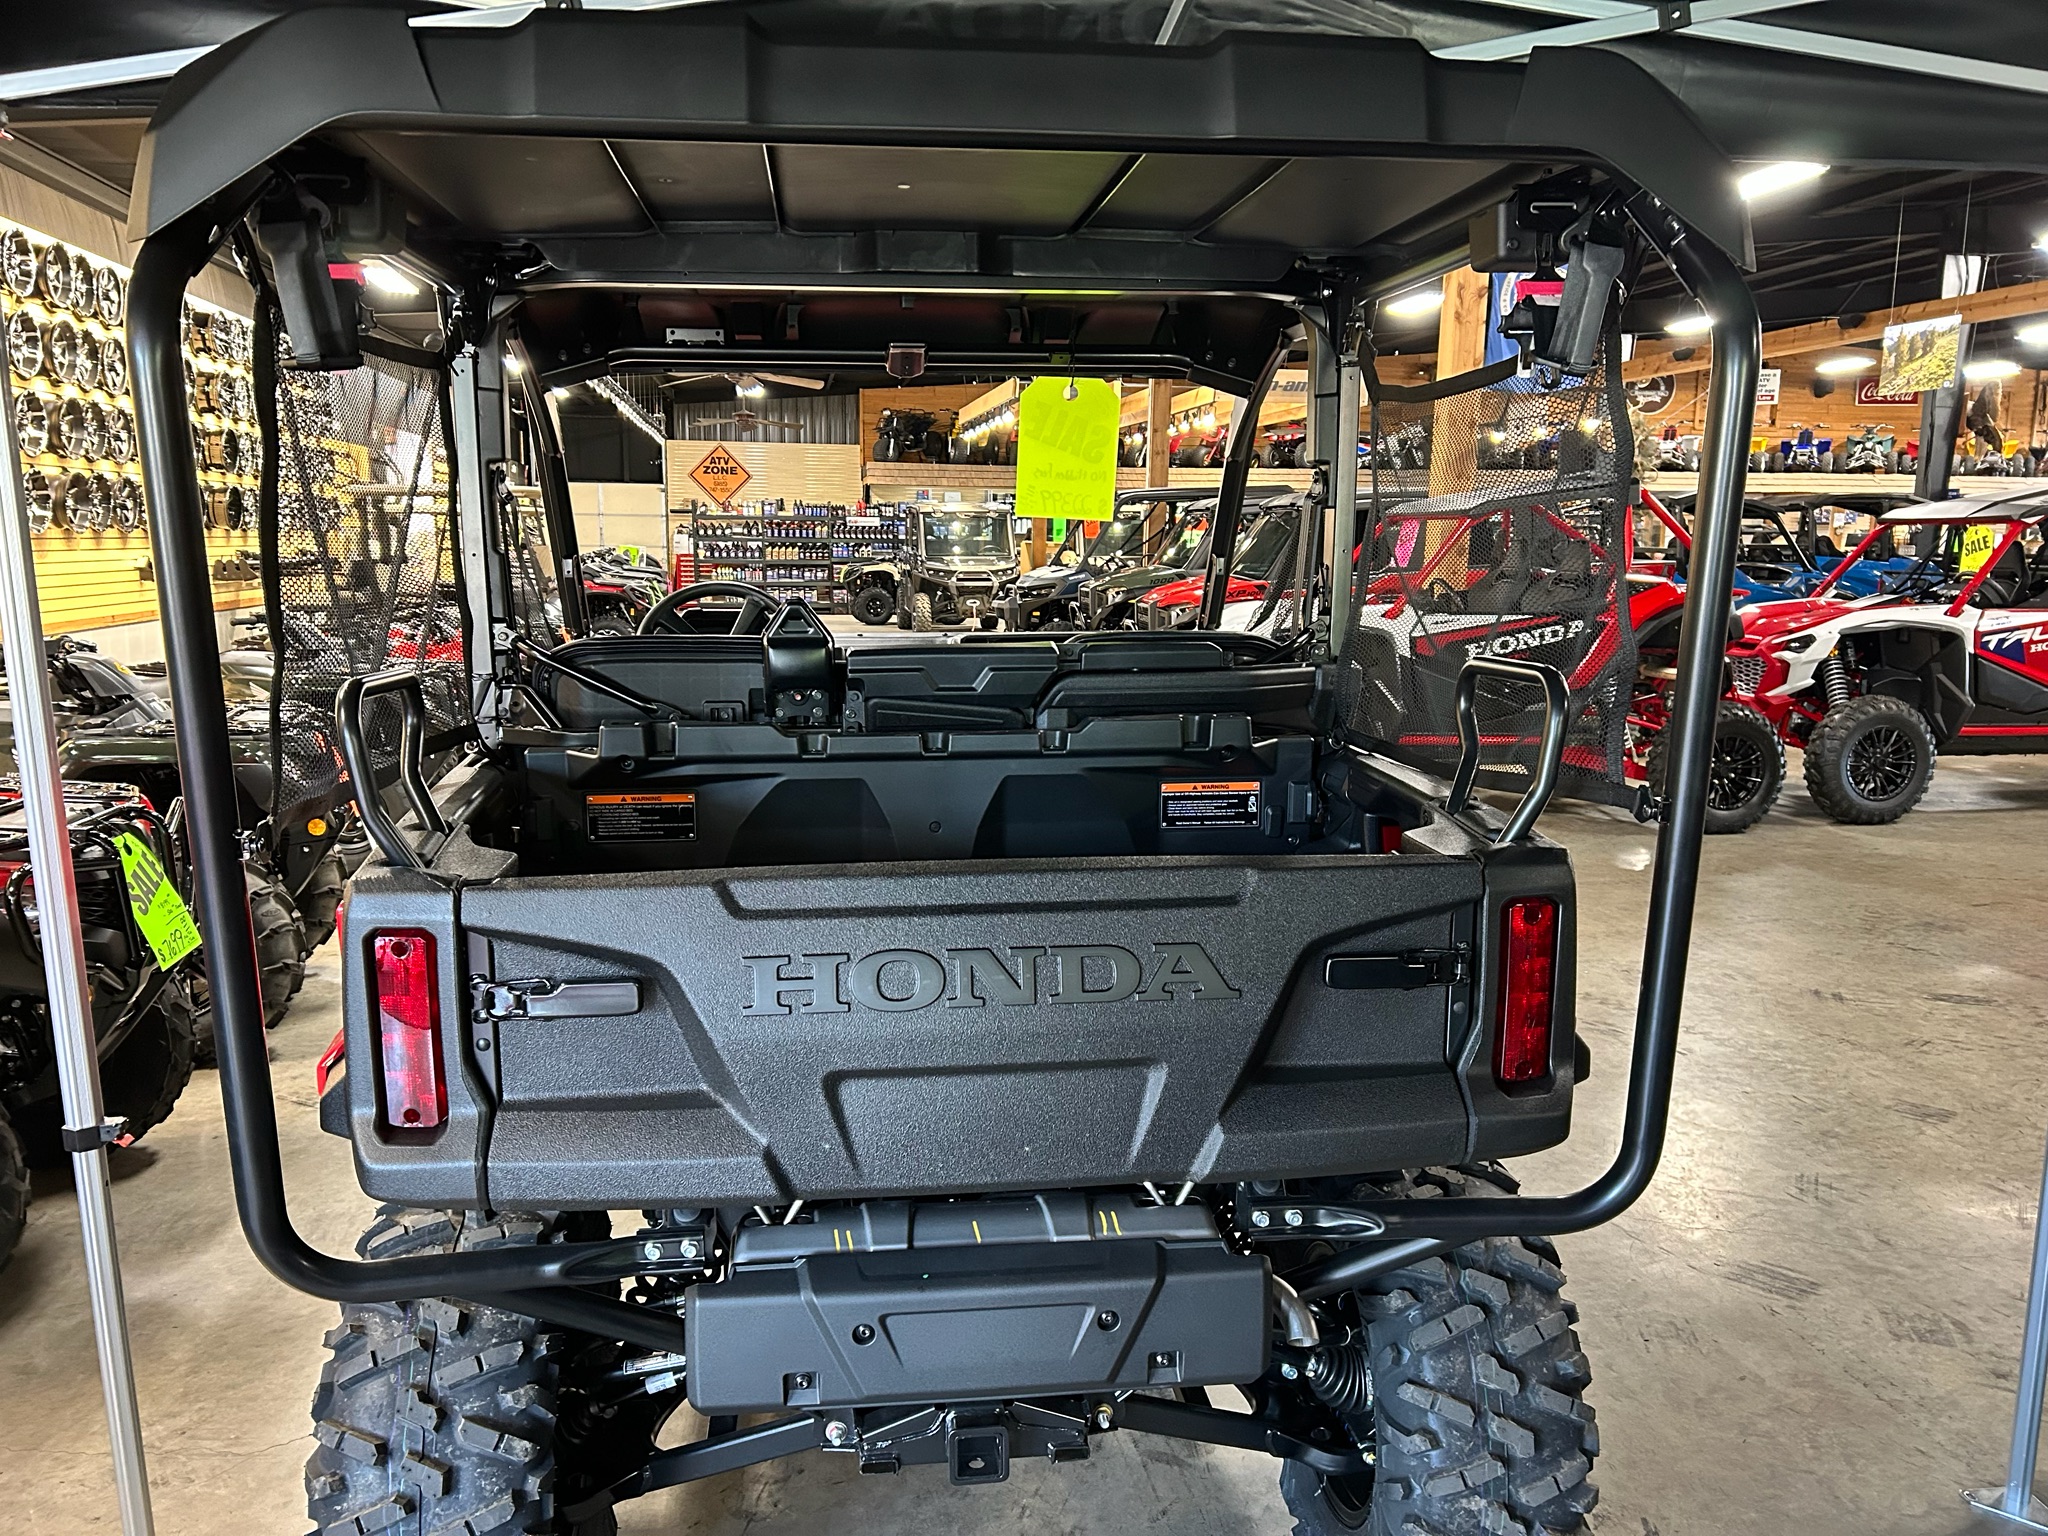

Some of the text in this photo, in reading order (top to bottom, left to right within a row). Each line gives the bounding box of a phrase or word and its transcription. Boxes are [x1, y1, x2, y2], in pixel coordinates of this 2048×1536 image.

[1861, 382, 1915, 401] CocCola
[702, 466, 738, 475] ZONE
[709, 456, 730, 466] ATV
[1964, 535, 1991, 557] SALE
[1150, 577, 1175, 585] 1000
[1226, 590, 1247, 598] XP
[1981, 626, 2048, 651] TAL
[127, 849, 165, 917] SALE
[741, 941, 1242, 1017] HONDA
